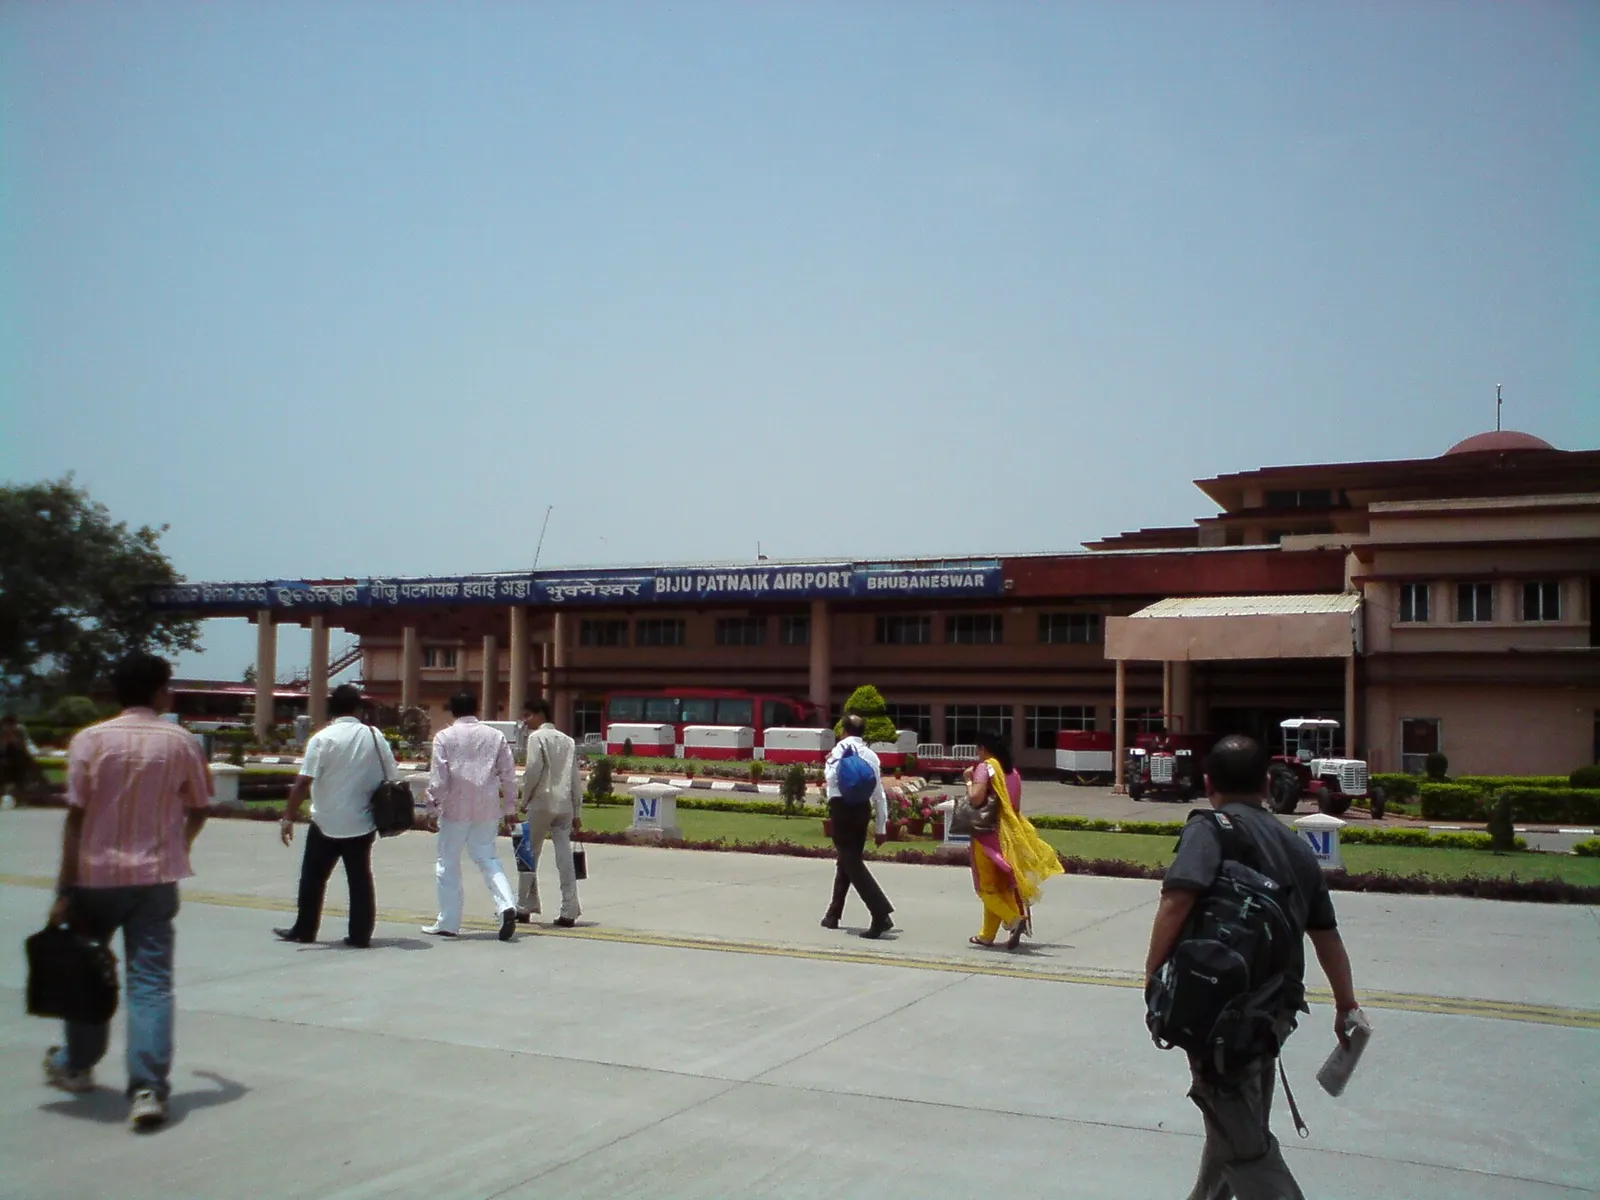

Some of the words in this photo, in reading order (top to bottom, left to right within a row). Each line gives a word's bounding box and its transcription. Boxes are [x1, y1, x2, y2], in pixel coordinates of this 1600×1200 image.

[401, 582, 459, 598] पटनायक
[461, 577, 497, 599] हवाई
[655, 576, 692, 593] BIJU
[696, 573, 770, 592] PATNAIK
[773, 571, 852, 590] AIRPORT
[867, 574, 985, 590] BHUBANESWAR
